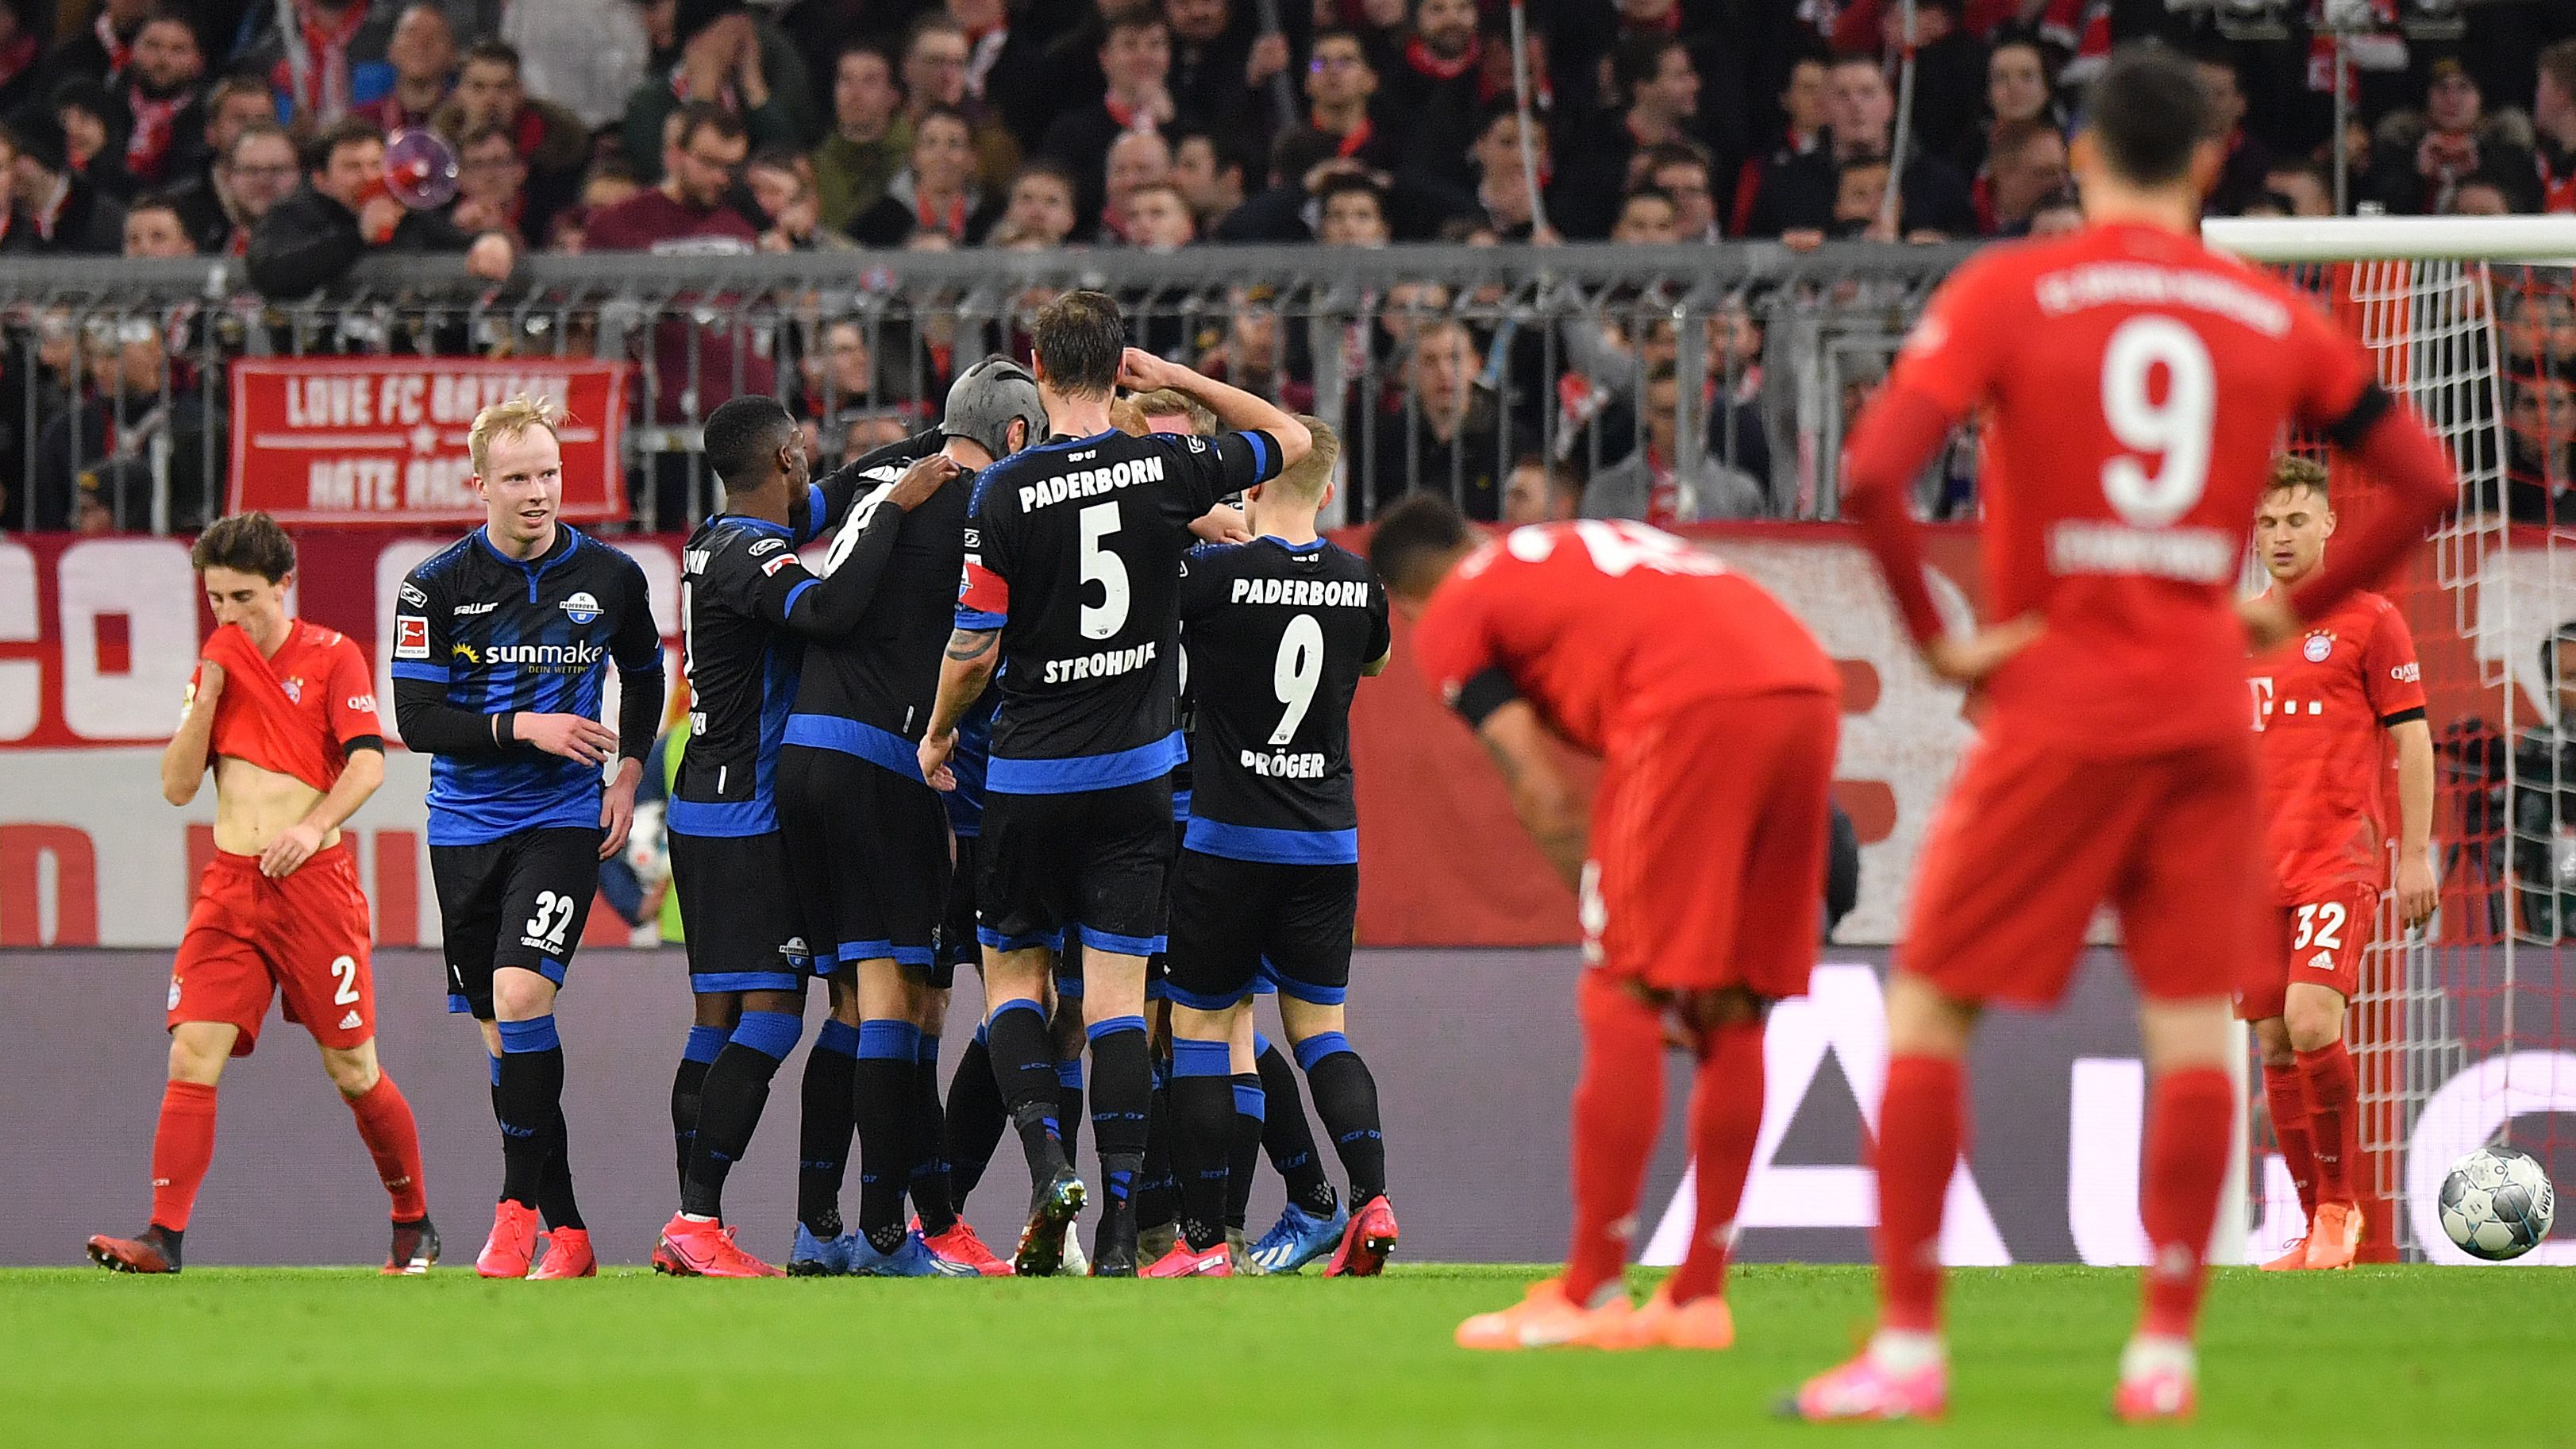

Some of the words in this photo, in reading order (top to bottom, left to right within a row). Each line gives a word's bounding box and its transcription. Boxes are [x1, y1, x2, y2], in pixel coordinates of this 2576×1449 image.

[287, 376, 372, 427] LOVE
[379, 376, 423, 425] FC
[2100, 314, 2217, 527] 9
[309, 457, 395, 510] HATE
[1018, 456, 1165, 514] PADERBORN
[1080, 500, 1130, 640] 5
[1230, 579, 1369, 607] PADERBORN
[453, 602, 499, 616] saller
[485, 639, 604, 664] sunmake
[528, 665, 551, 674] DEIN
[1267, 614, 1324, 745] 9
[526, 890, 574, 946] 32
[2293, 900, 2347, 950] 32
[331, 954, 360, 1006] 2
[1341, 1130, 1365, 1143] SCP
